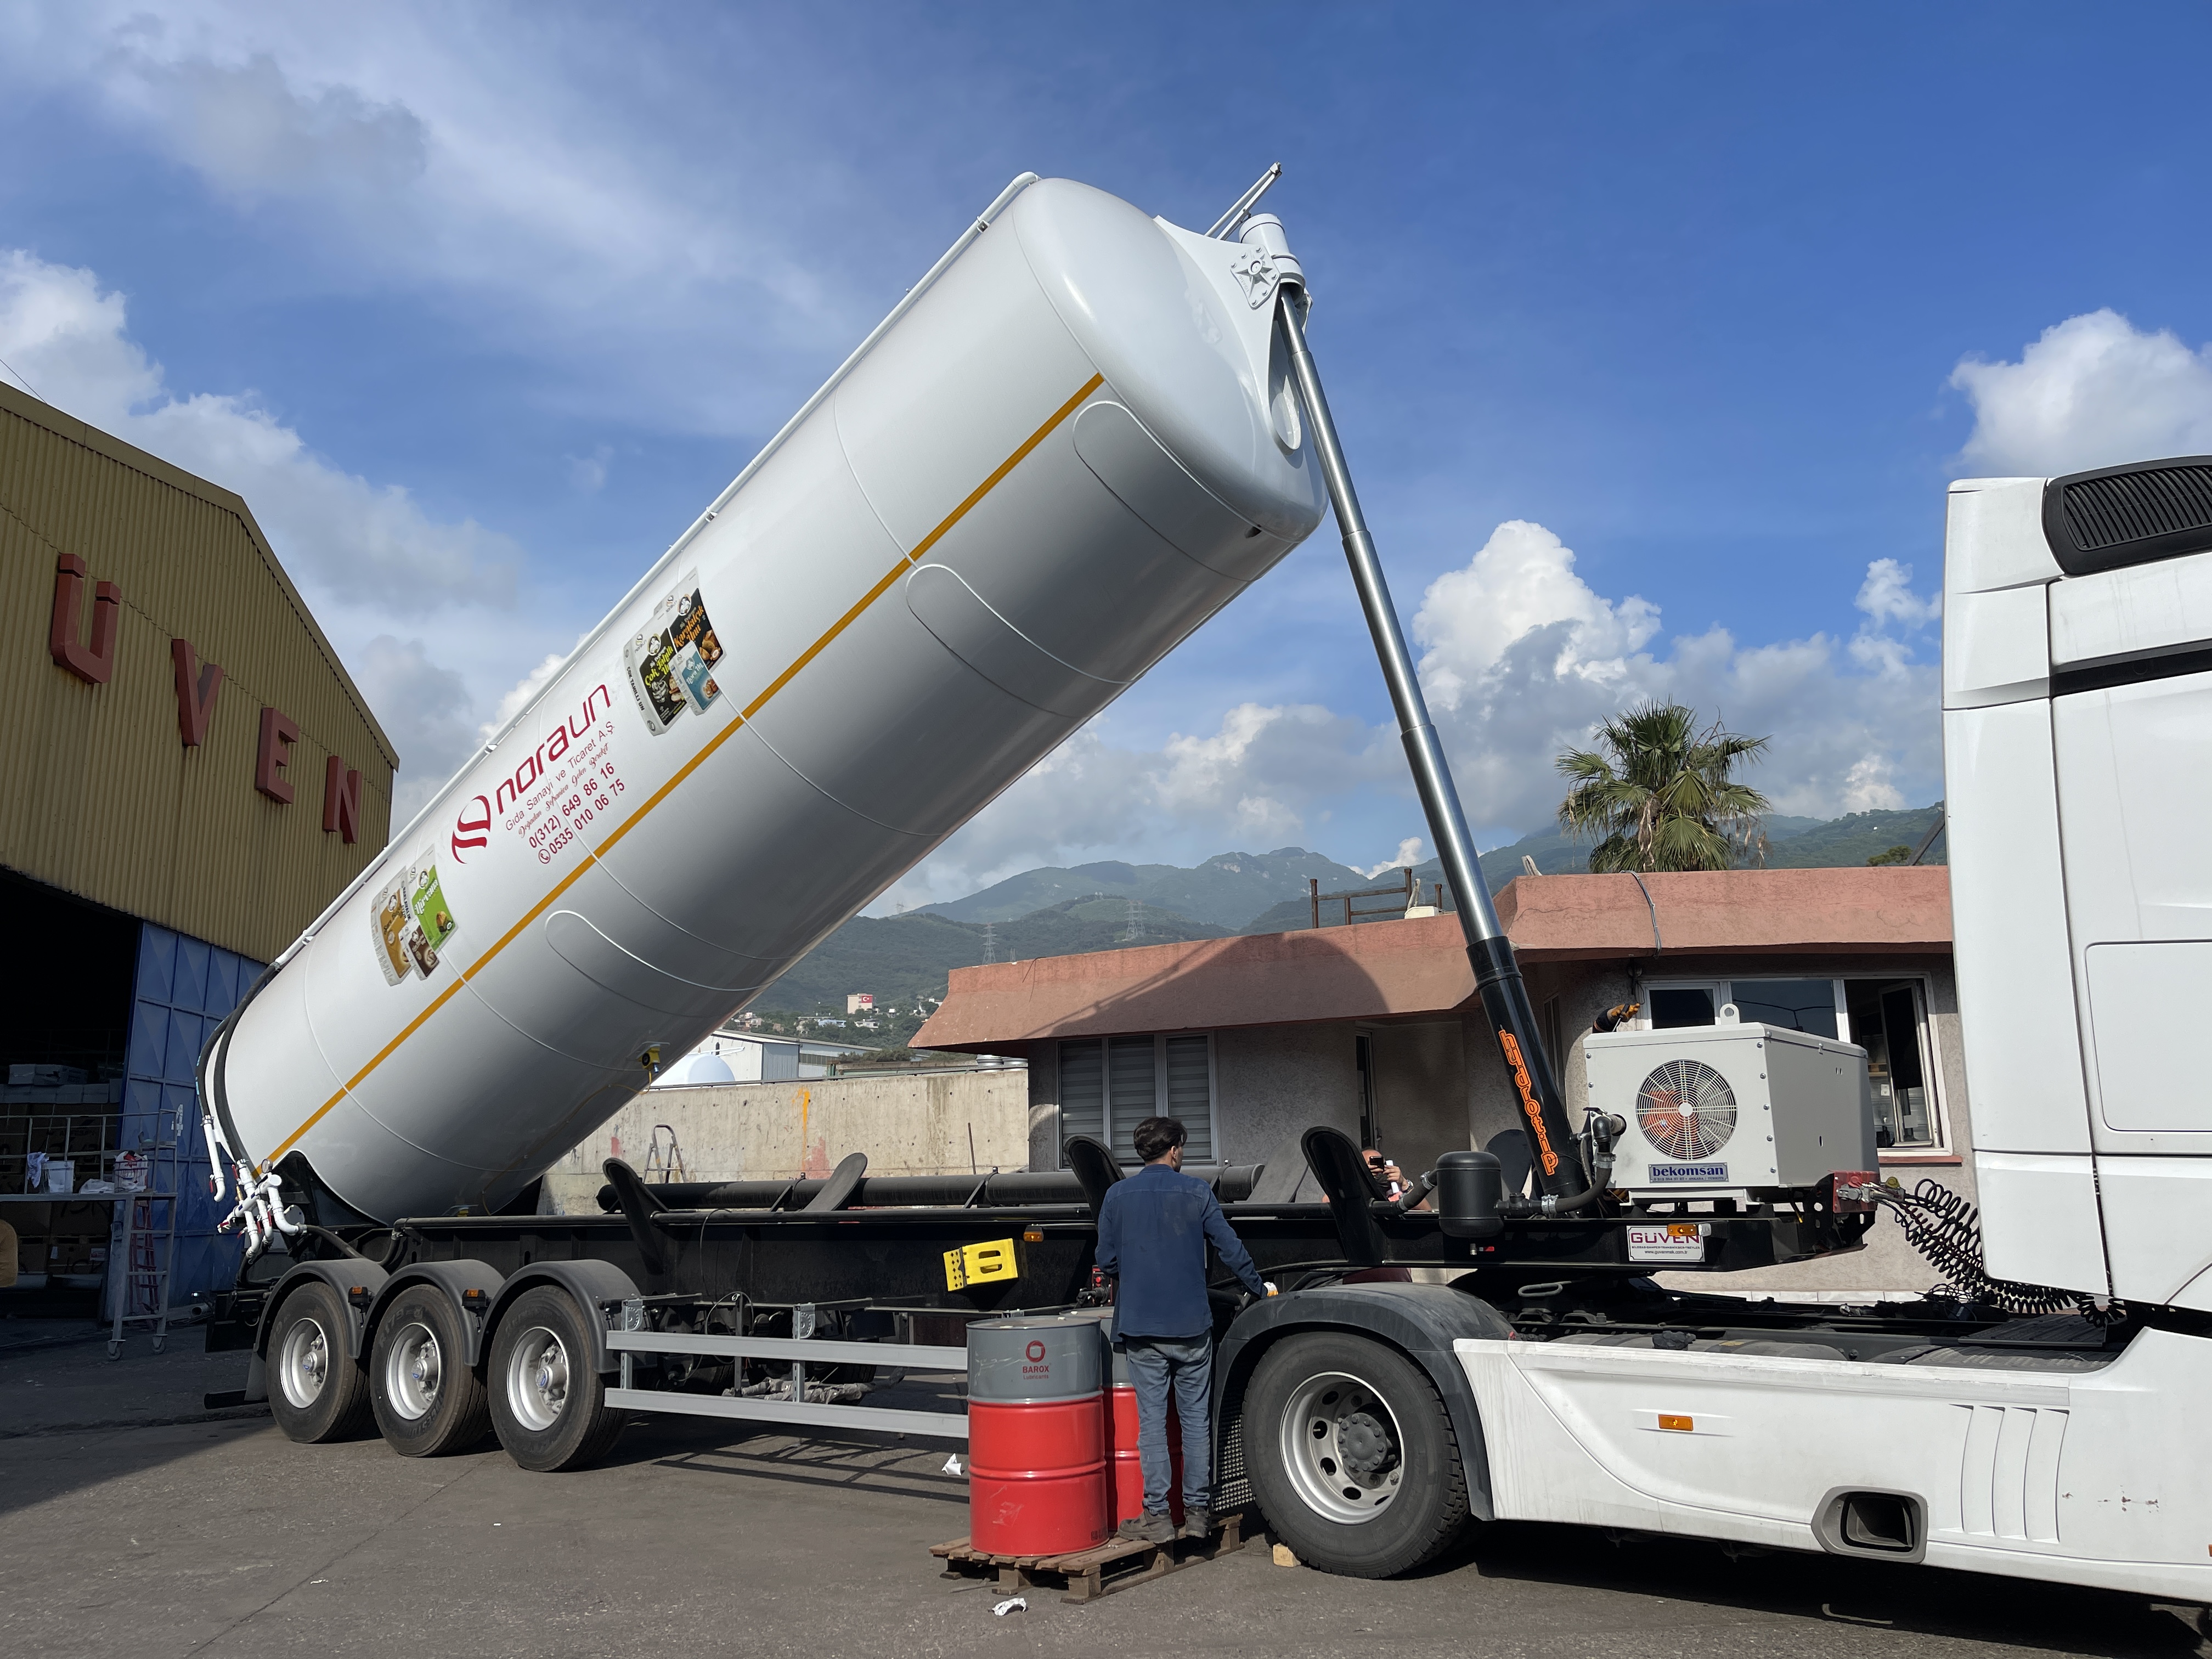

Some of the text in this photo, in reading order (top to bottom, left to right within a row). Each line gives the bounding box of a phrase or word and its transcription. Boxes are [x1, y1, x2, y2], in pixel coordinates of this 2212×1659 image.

[496, 684, 611, 815] noraun
[505, 810, 525, 831] Gıda
[526, 778, 554, 811] Sanayi
[555, 770, 566, 782] ve
[567, 738, 596, 769] Ticaret
[529, 762, 615, 848] 0(312) 649 86 16
[549, 778, 625, 854] 0535 010 06 75
[1498, 1029, 1559, 1176] hydrotip
[1652, 1166, 1724, 1176] bekomsan
[1630, 1232, 1700, 1244] GÜVEN
[1022, 1365, 1049, 1373] BAROX
